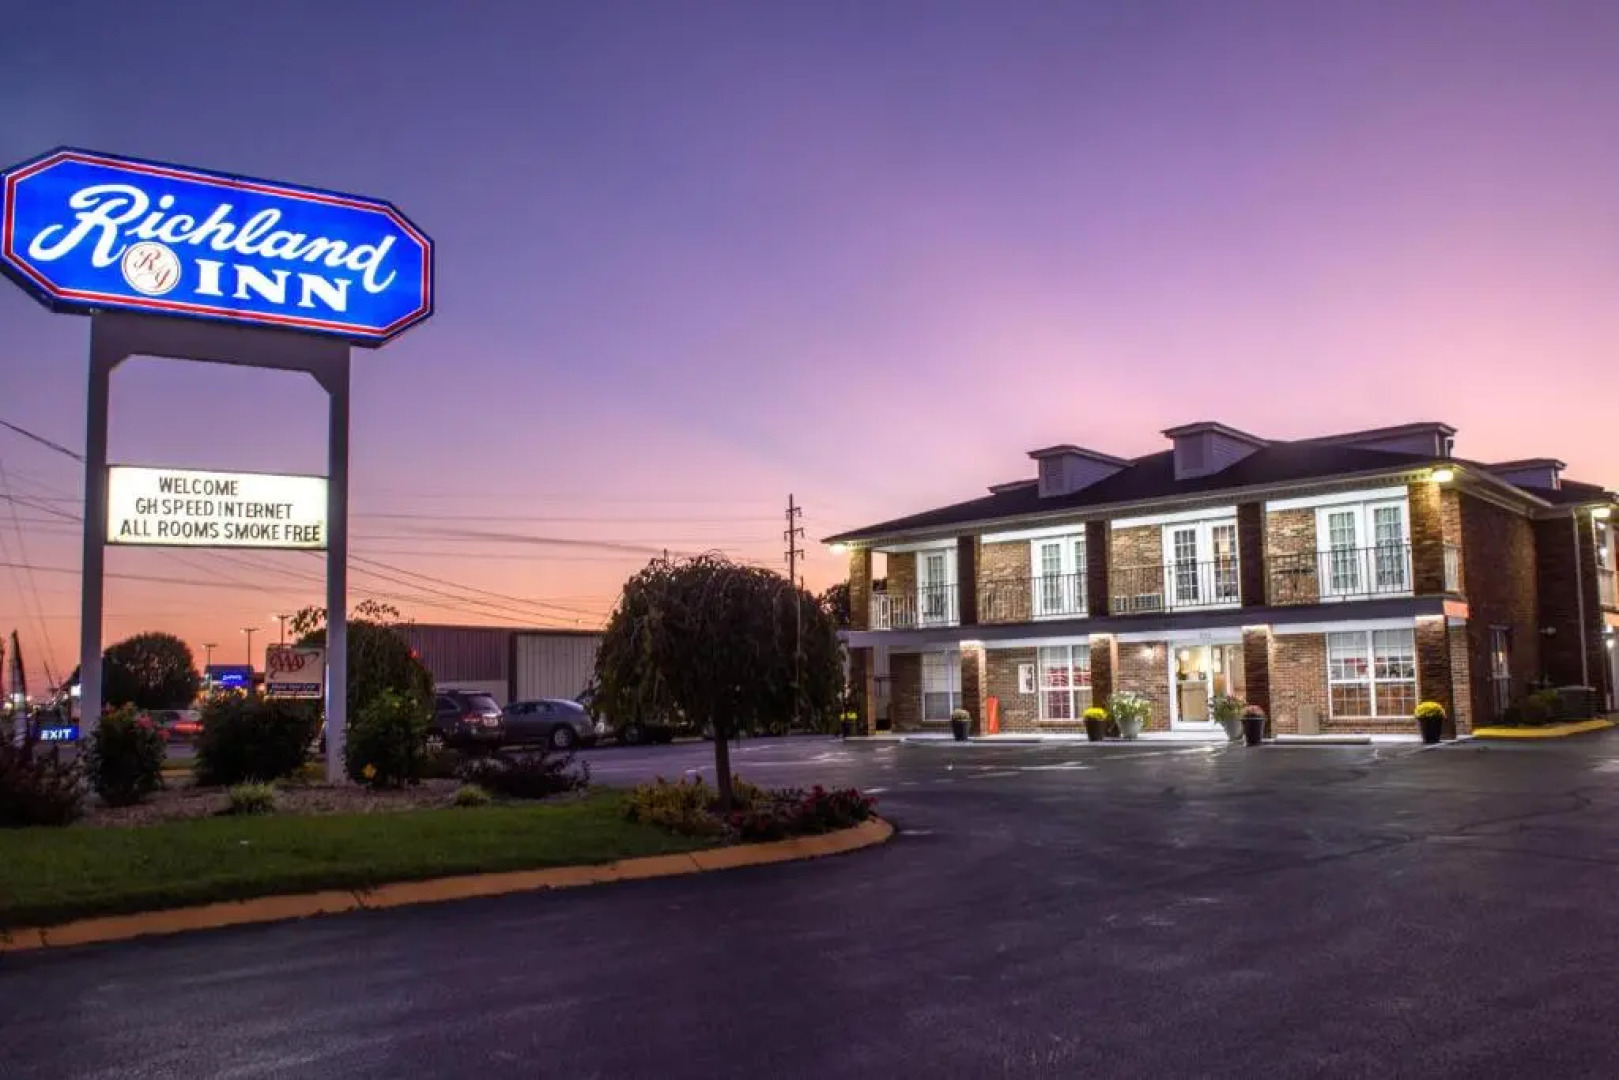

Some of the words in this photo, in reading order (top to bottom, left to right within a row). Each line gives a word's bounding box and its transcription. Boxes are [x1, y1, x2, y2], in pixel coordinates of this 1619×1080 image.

[29, 184, 397, 294] Richland
[195, 258, 352, 312] INN
[159, 477, 239, 496] WELCOME
[162, 498, 214, 516] SPEED
[217, 501, 294, 520] INTERNET
[120, 518, 151, 536] ALL
[157, 519, 219, 539] ROOMS
[224, 522, 279, 540] SMOKE
[283, 523, 321, 542] FREE
[41, 728, 72, 741] EXIT
